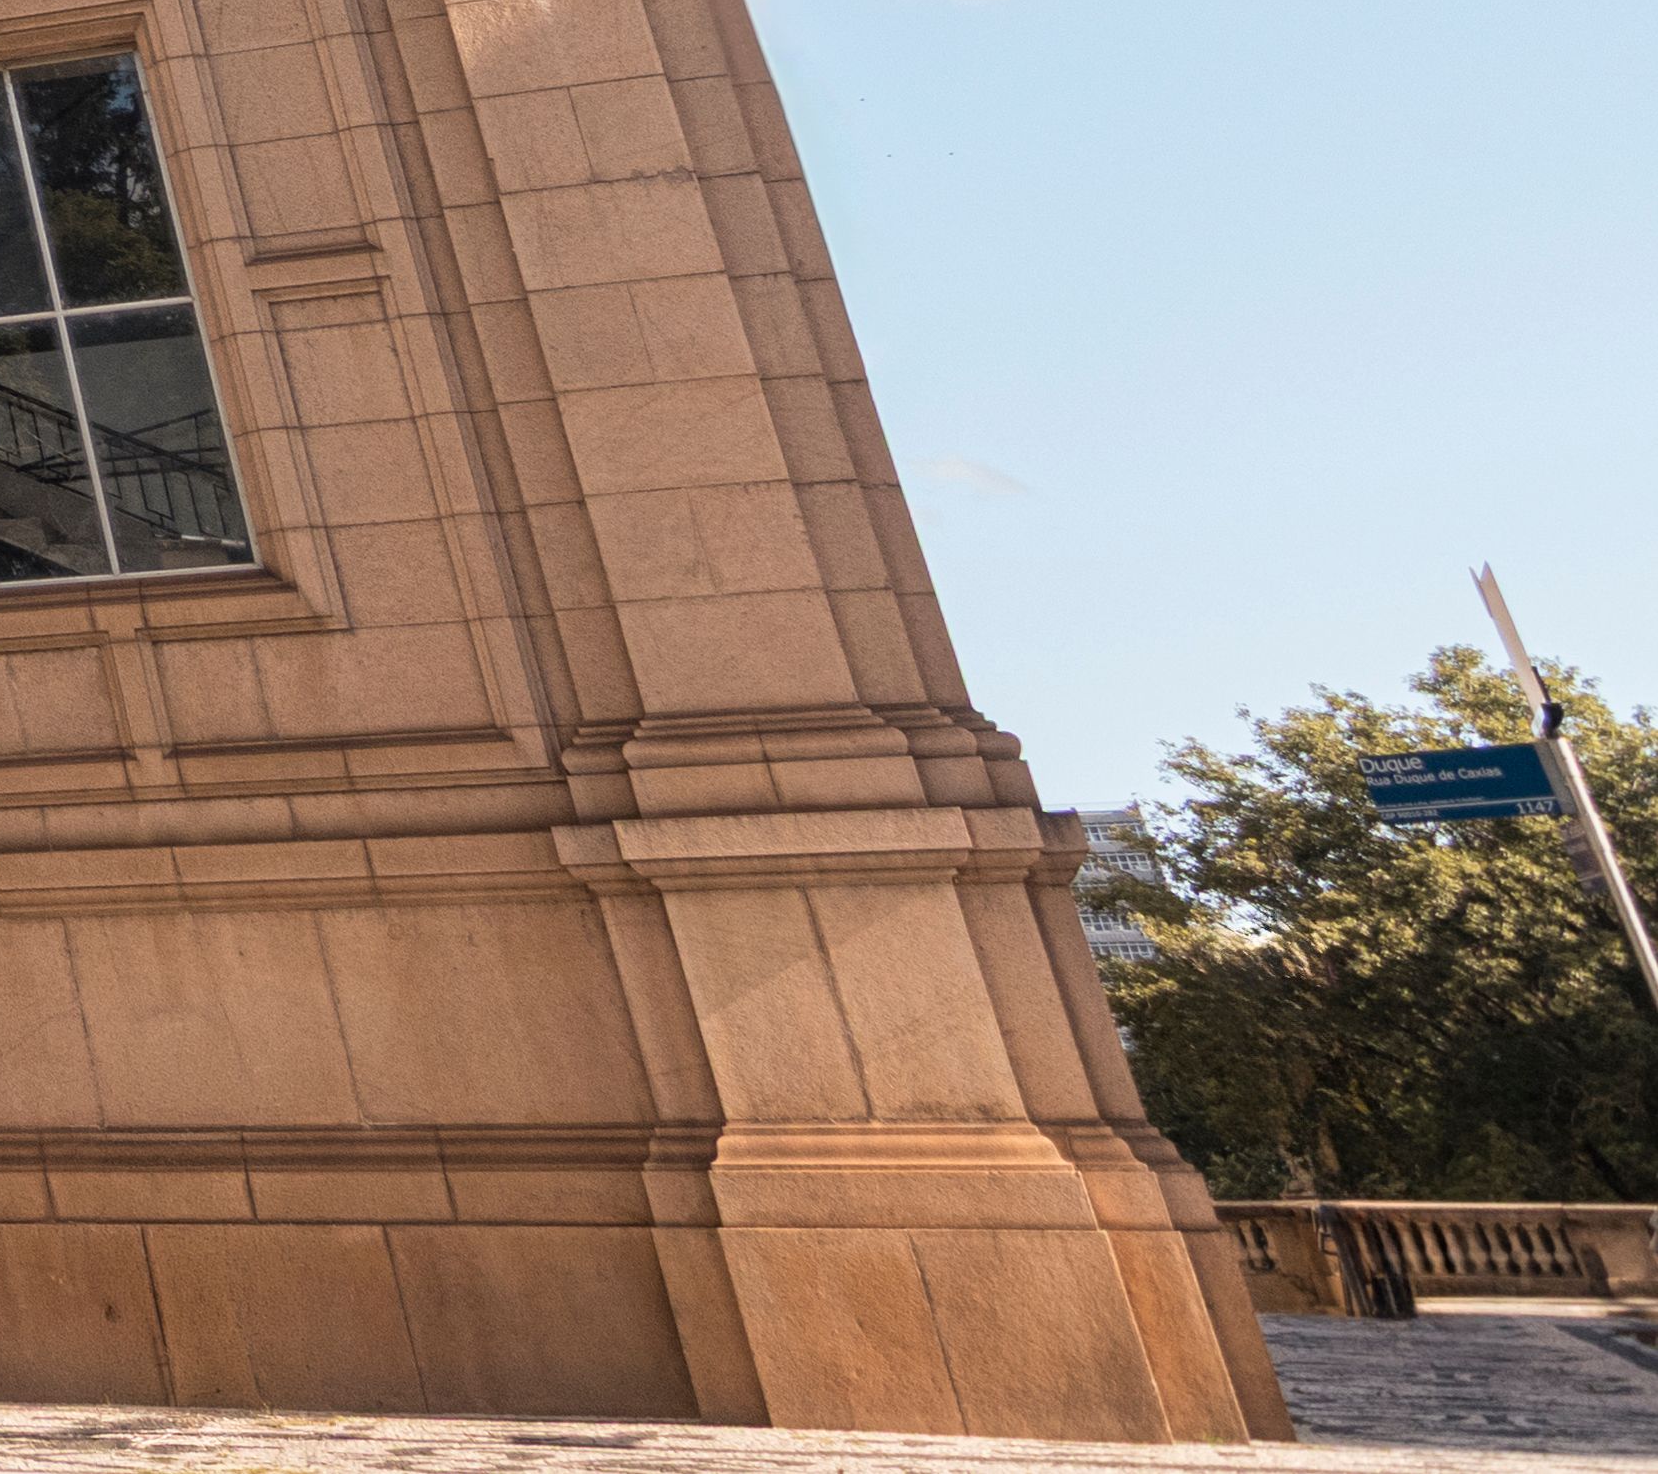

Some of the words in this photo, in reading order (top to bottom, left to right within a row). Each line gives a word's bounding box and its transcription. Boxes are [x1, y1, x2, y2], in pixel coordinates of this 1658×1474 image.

[1358, 757, 1423, 773] Duque
[1366, 776, 1391, 786] Rua
[1393, 772, 1435, 785] Duque
[1439, 769, 1456, 780] de
[1457, 767, 1503, 779] Caxias
[1516, 801, 1554, 814] 1147
